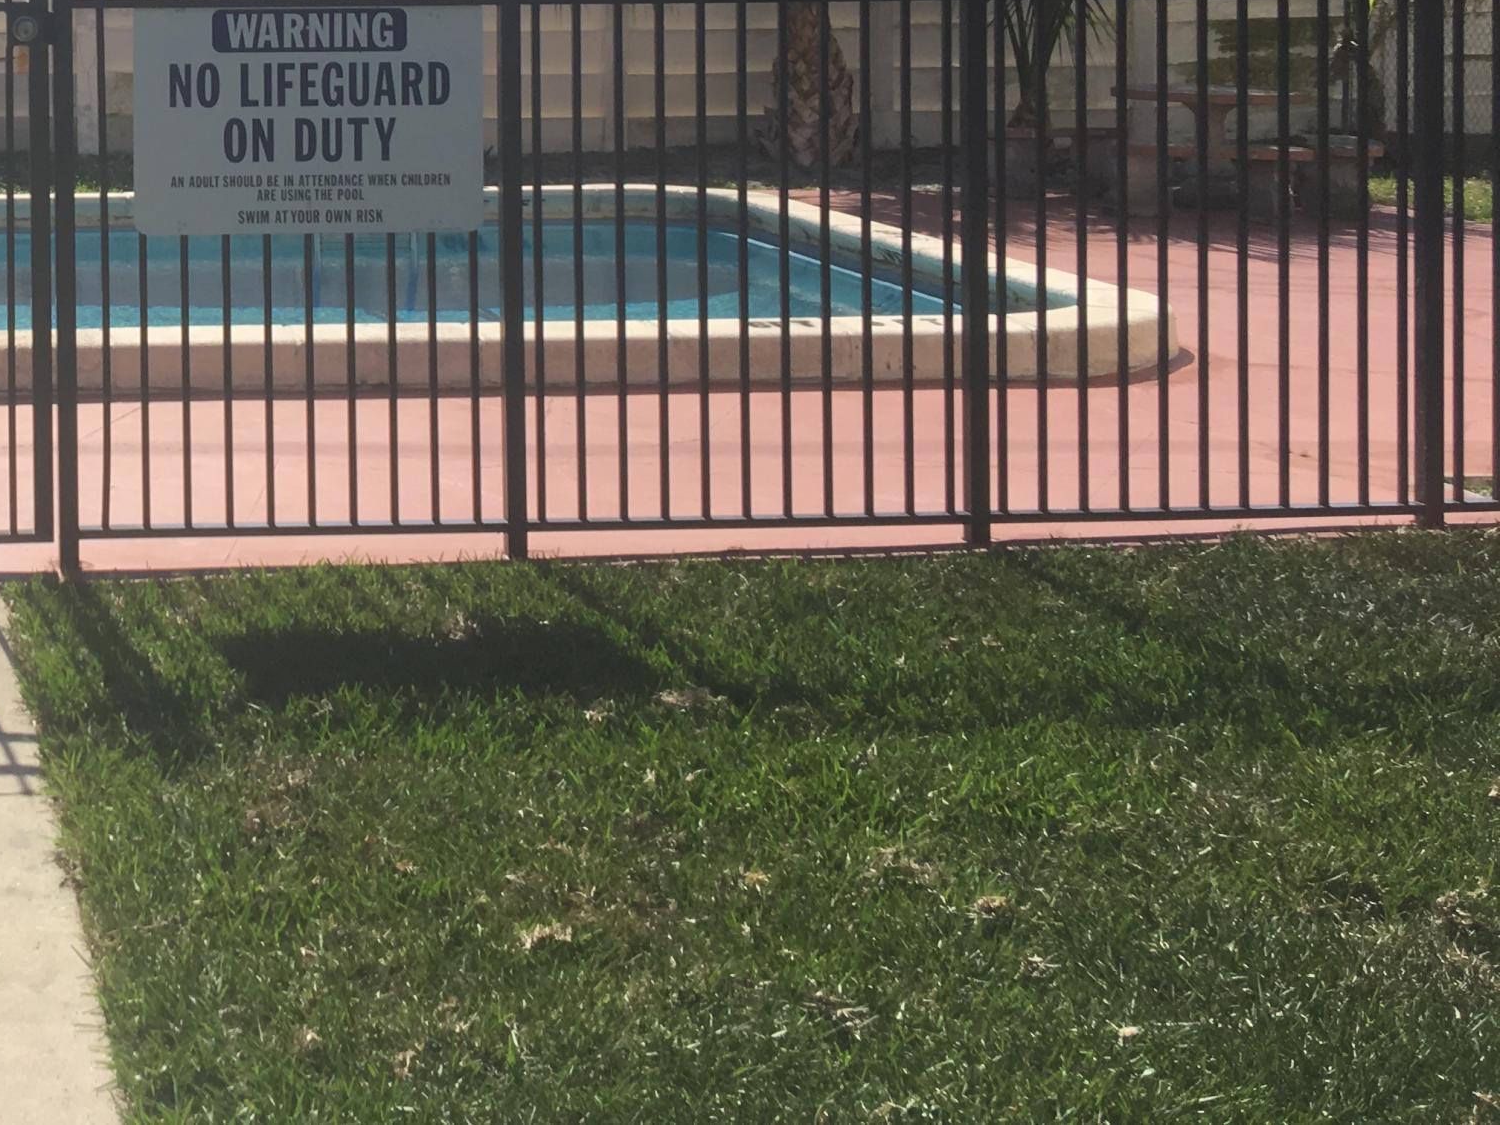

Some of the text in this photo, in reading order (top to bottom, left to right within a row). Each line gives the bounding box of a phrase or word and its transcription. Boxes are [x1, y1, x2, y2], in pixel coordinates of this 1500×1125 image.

[225, 11, 395, 50] WARNING
[168, 61, 451, 108] NO LIFEGUARD
[223, 116, 397, 164] ON DUTY
[170, 173, 451, 188] AN ADULT SHOULD BE IN ATTENDANCE WHEN CHILDREN
[257, 188, 364, 202] ARE USING THE POOL
[238, 209, 383, 224] SWIM AT YOUR OWN RISK
